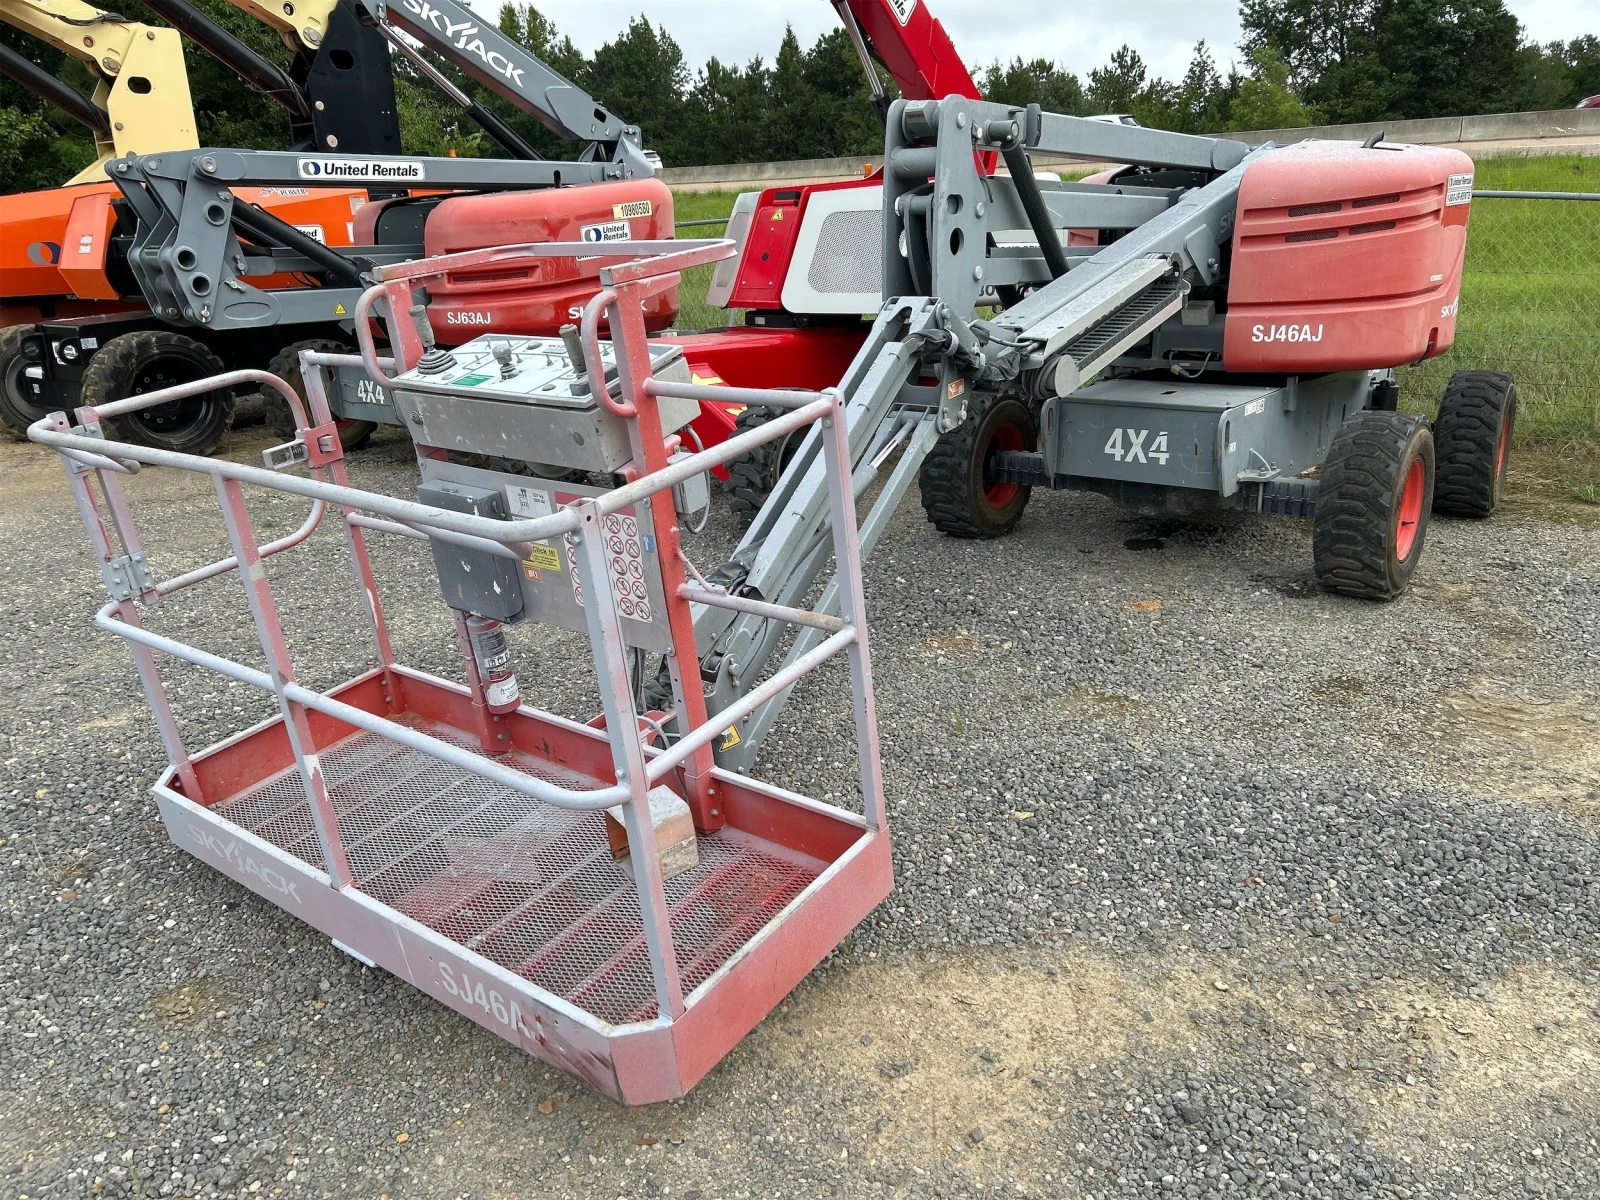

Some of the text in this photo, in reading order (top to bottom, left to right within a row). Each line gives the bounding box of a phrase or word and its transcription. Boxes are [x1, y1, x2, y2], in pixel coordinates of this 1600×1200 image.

[403, 0, 525, 88] SKYJACK
[324, 162, 419, 177] United Rentals
[620, 202, 650, 217] 10980580
[602, 223, 625, 234] United
[603, 232, 628, 241] Rentals
[447, 311, 492, 325] SJ63AJ
[1251, 323, 1324, 343] SJ46AJ
[357, 379, 385, 404] 4X4
[1103, 428, 1170, 465] 4X4
[187, 823, 302, 904] SKYJACK
